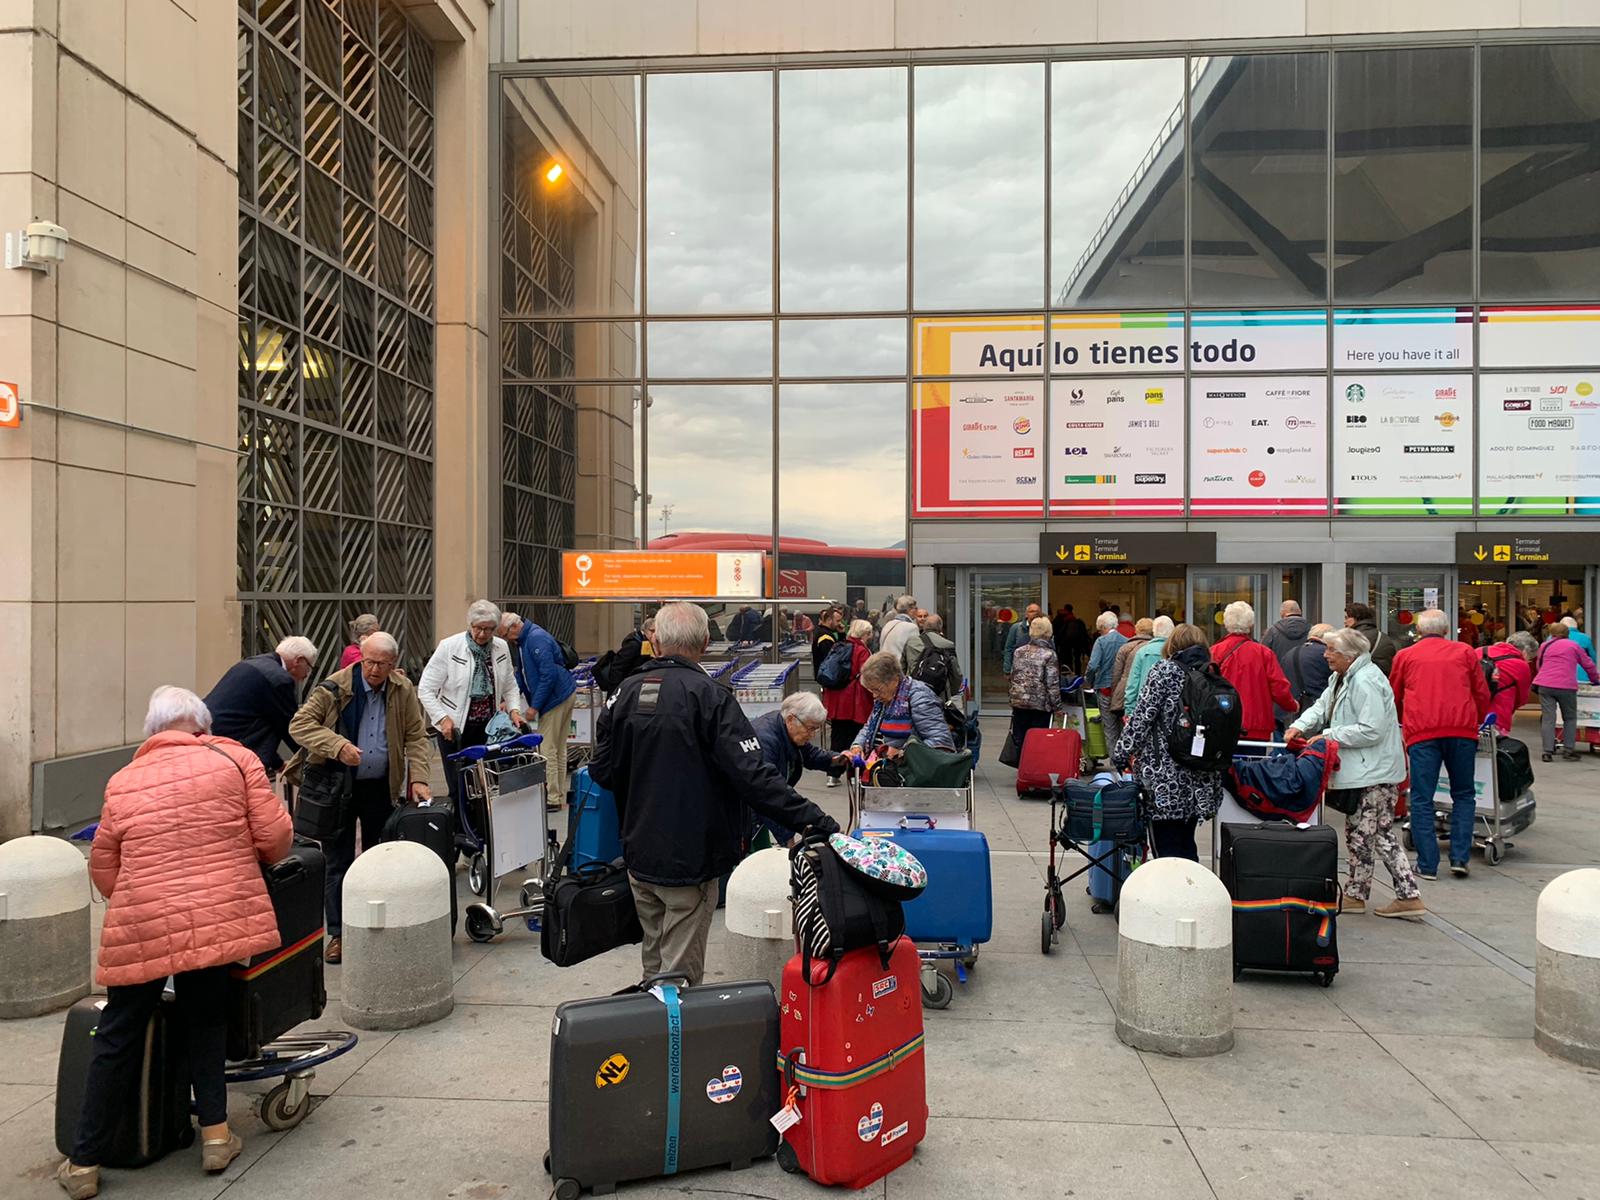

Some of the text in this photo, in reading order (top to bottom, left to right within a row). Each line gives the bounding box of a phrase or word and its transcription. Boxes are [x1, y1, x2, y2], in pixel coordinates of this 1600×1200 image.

[978, 338, 1257, 371] Aquí lo tienes todo
[1346, 348, 1460, 362] Here you have it all
[1106, 396, 1125, 404] pans
[1145, 392, 1164, 400] pans
[1380, 416, 1388, 424] LA
[1515, 553, 1549, 561] Terminal
[739, 737, 761, 753] HH
[670, 1014, 681, 1095] wereldcontact
[599, 1061, 627, 1085] NL
[667, 1135, 677, 1168] reizen
